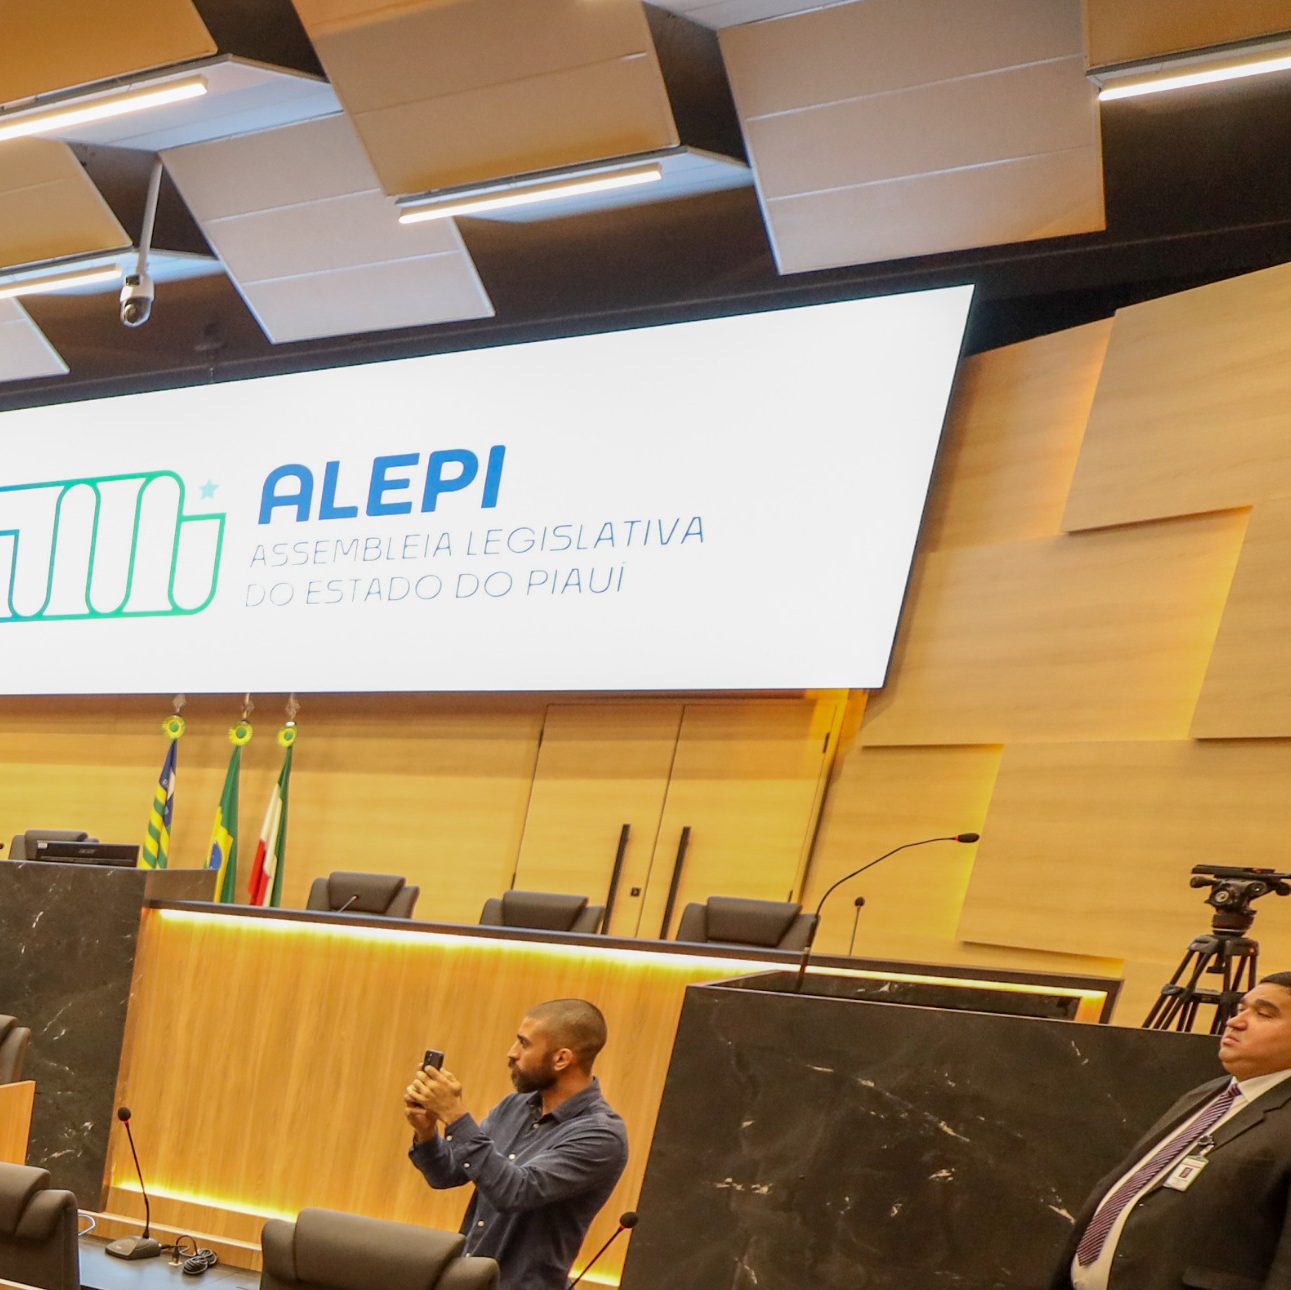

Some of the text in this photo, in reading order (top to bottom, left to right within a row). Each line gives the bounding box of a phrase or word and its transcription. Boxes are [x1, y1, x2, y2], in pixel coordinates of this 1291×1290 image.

[257, 444, 507, 525] ALEPI
[249, 515, 704, 568] ASSEMBLEIA LEGISLATIVA
[245, 560, 627, 608] DO ESTADO DO PIAUÍ
